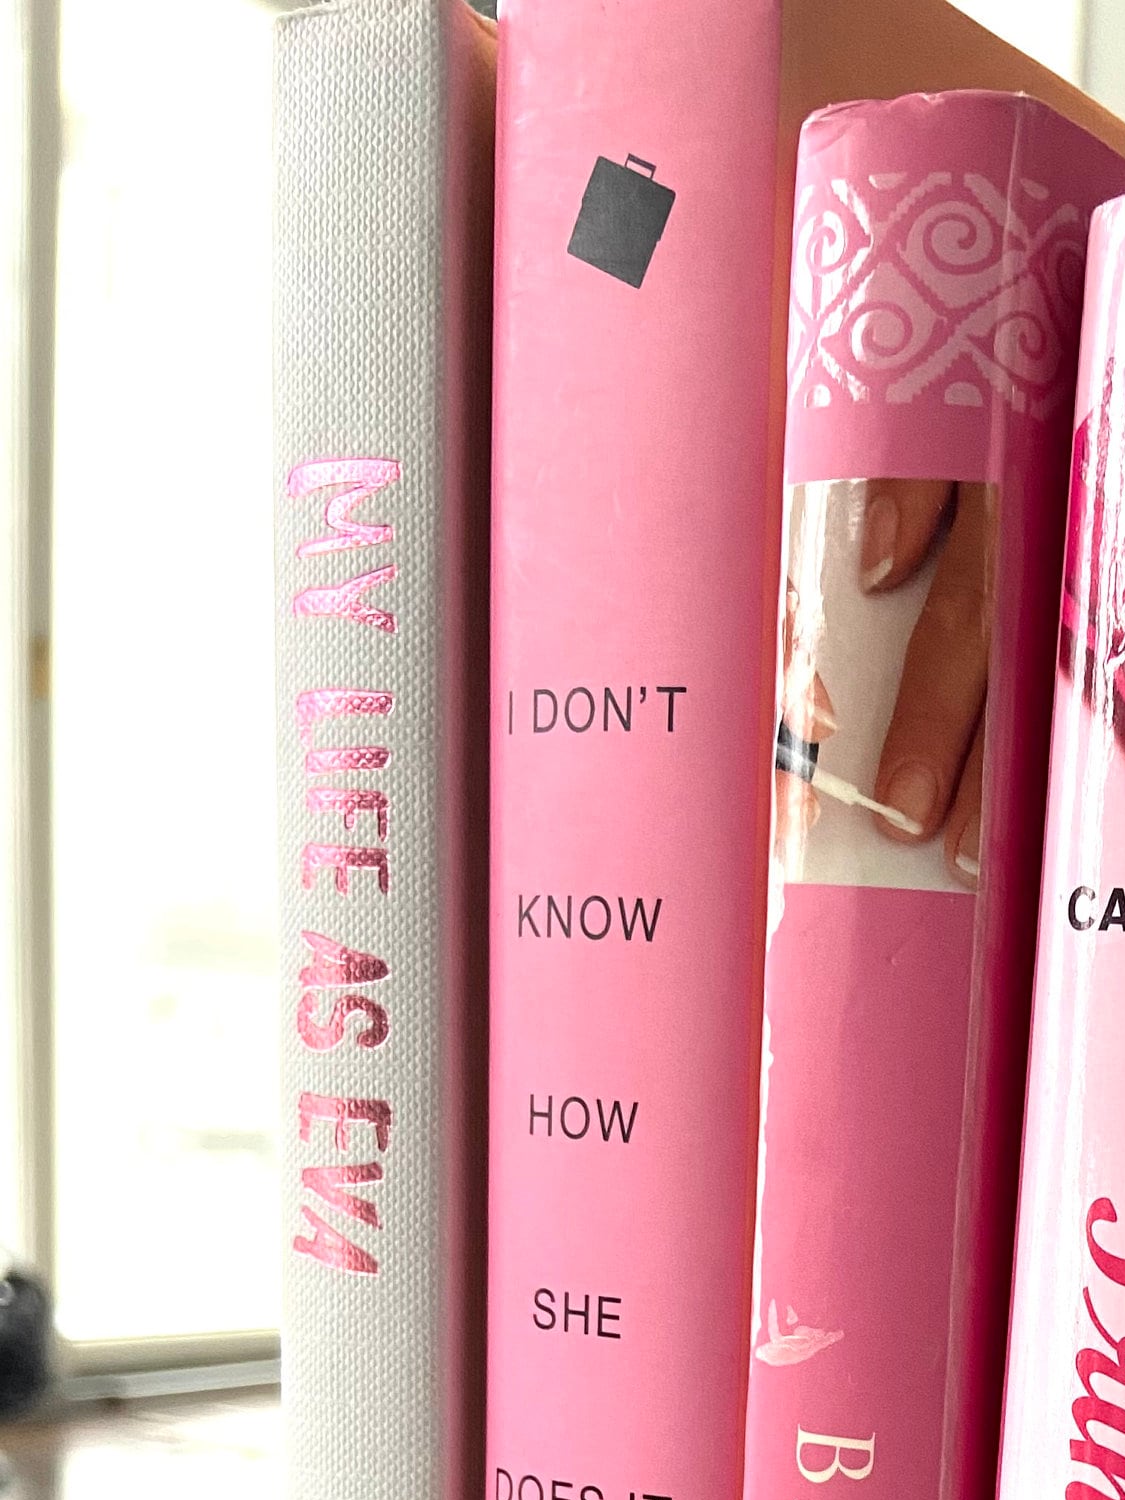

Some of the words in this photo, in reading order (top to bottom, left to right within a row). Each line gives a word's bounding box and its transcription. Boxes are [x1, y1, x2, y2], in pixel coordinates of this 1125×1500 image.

[287, 456, 401, 634] MY
[531, 685, 688, 734] DON'T
[297, 686, 396, 895] LIFE
[516, 893, 664, 942] KNOW
[297, 929, 392, 1054] AS
[528, 1093, 640, 1144] HOW
[292, 1091, 393, 1277] EVA
[531, 1287, 623, 1340] SHE
